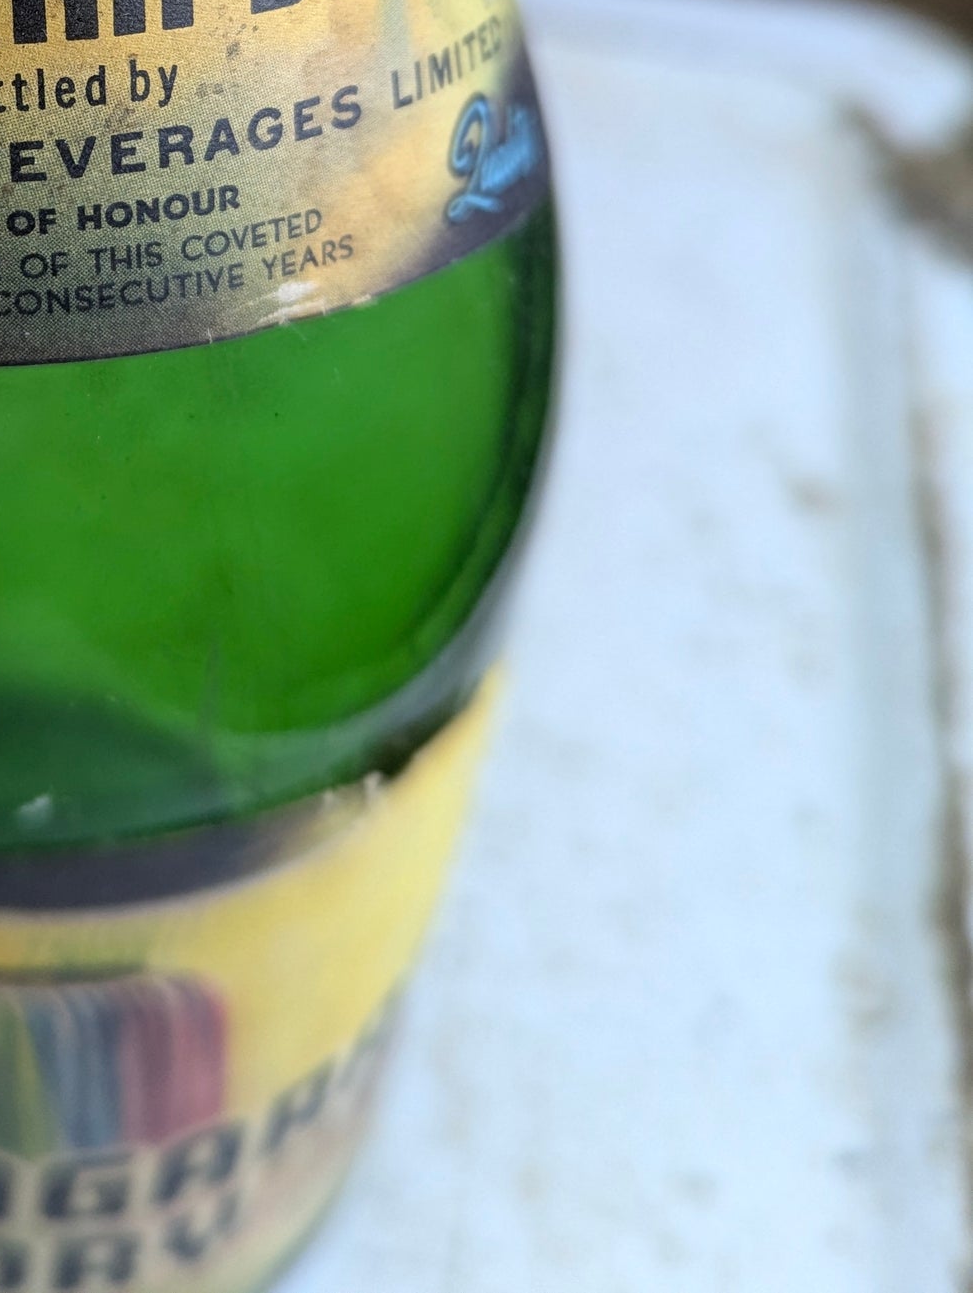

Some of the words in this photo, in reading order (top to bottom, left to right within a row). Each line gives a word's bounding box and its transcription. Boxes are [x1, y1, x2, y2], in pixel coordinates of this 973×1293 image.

[129, 59, 179, 108] by
[391, 15, 502, 107] LIMITED
[6, 207, 57, 237] OF
[77, 184, 241, 231] HONOUR
[20, 252, 69, 281] OF
[87, 236, 163, 277] THIS
[180, 209, 323, 262] COVETED
[260, 235, 355, 279] YEARS
